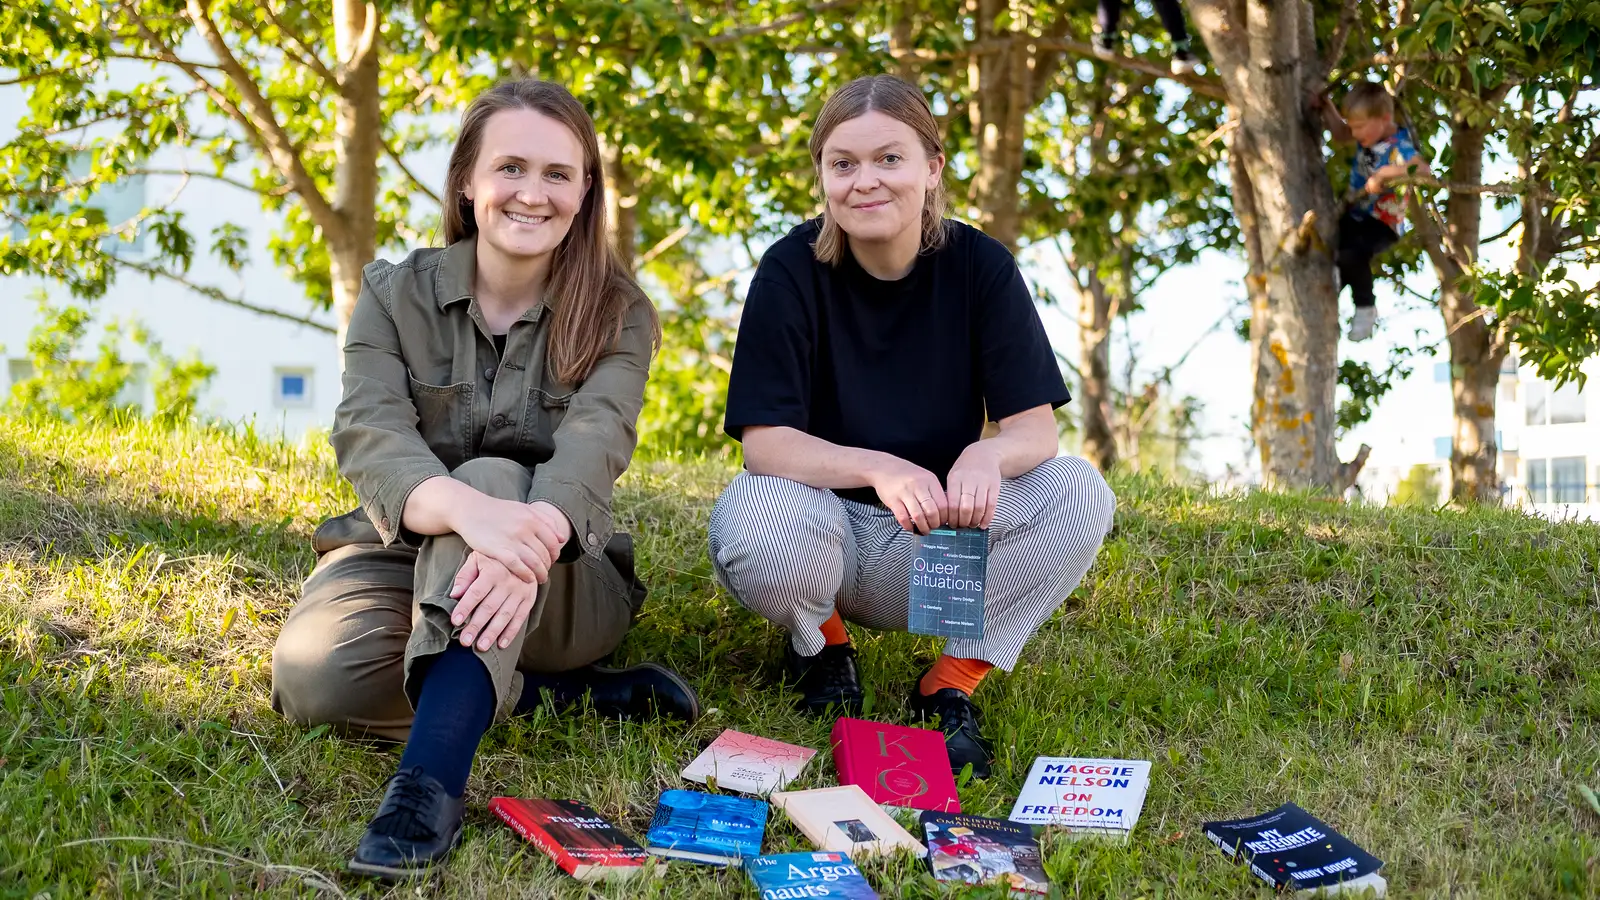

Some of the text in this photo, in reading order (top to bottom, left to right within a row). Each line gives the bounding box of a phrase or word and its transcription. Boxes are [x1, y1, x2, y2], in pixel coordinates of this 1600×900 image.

[913, 557, 960, 575] Queer
[913, 573, 982, 592] situations
[876, 731, 921, 762] K
[1044, 764, 1134, 777] MAGGIE
[1039, 776, 1129, 788] NELSON
[1063, 793, 1093, 802] ON
[1021, 805, 1123, 818] FREEDOM
[712, 819, 751, 828] Bluets
[1245, 826, 1320, 851] METEORITE
[1258, 828, 1282, 840] MY
[754, 857, 778, 866] The
[1290, 857, 1358, 880] HARRY DODGE
